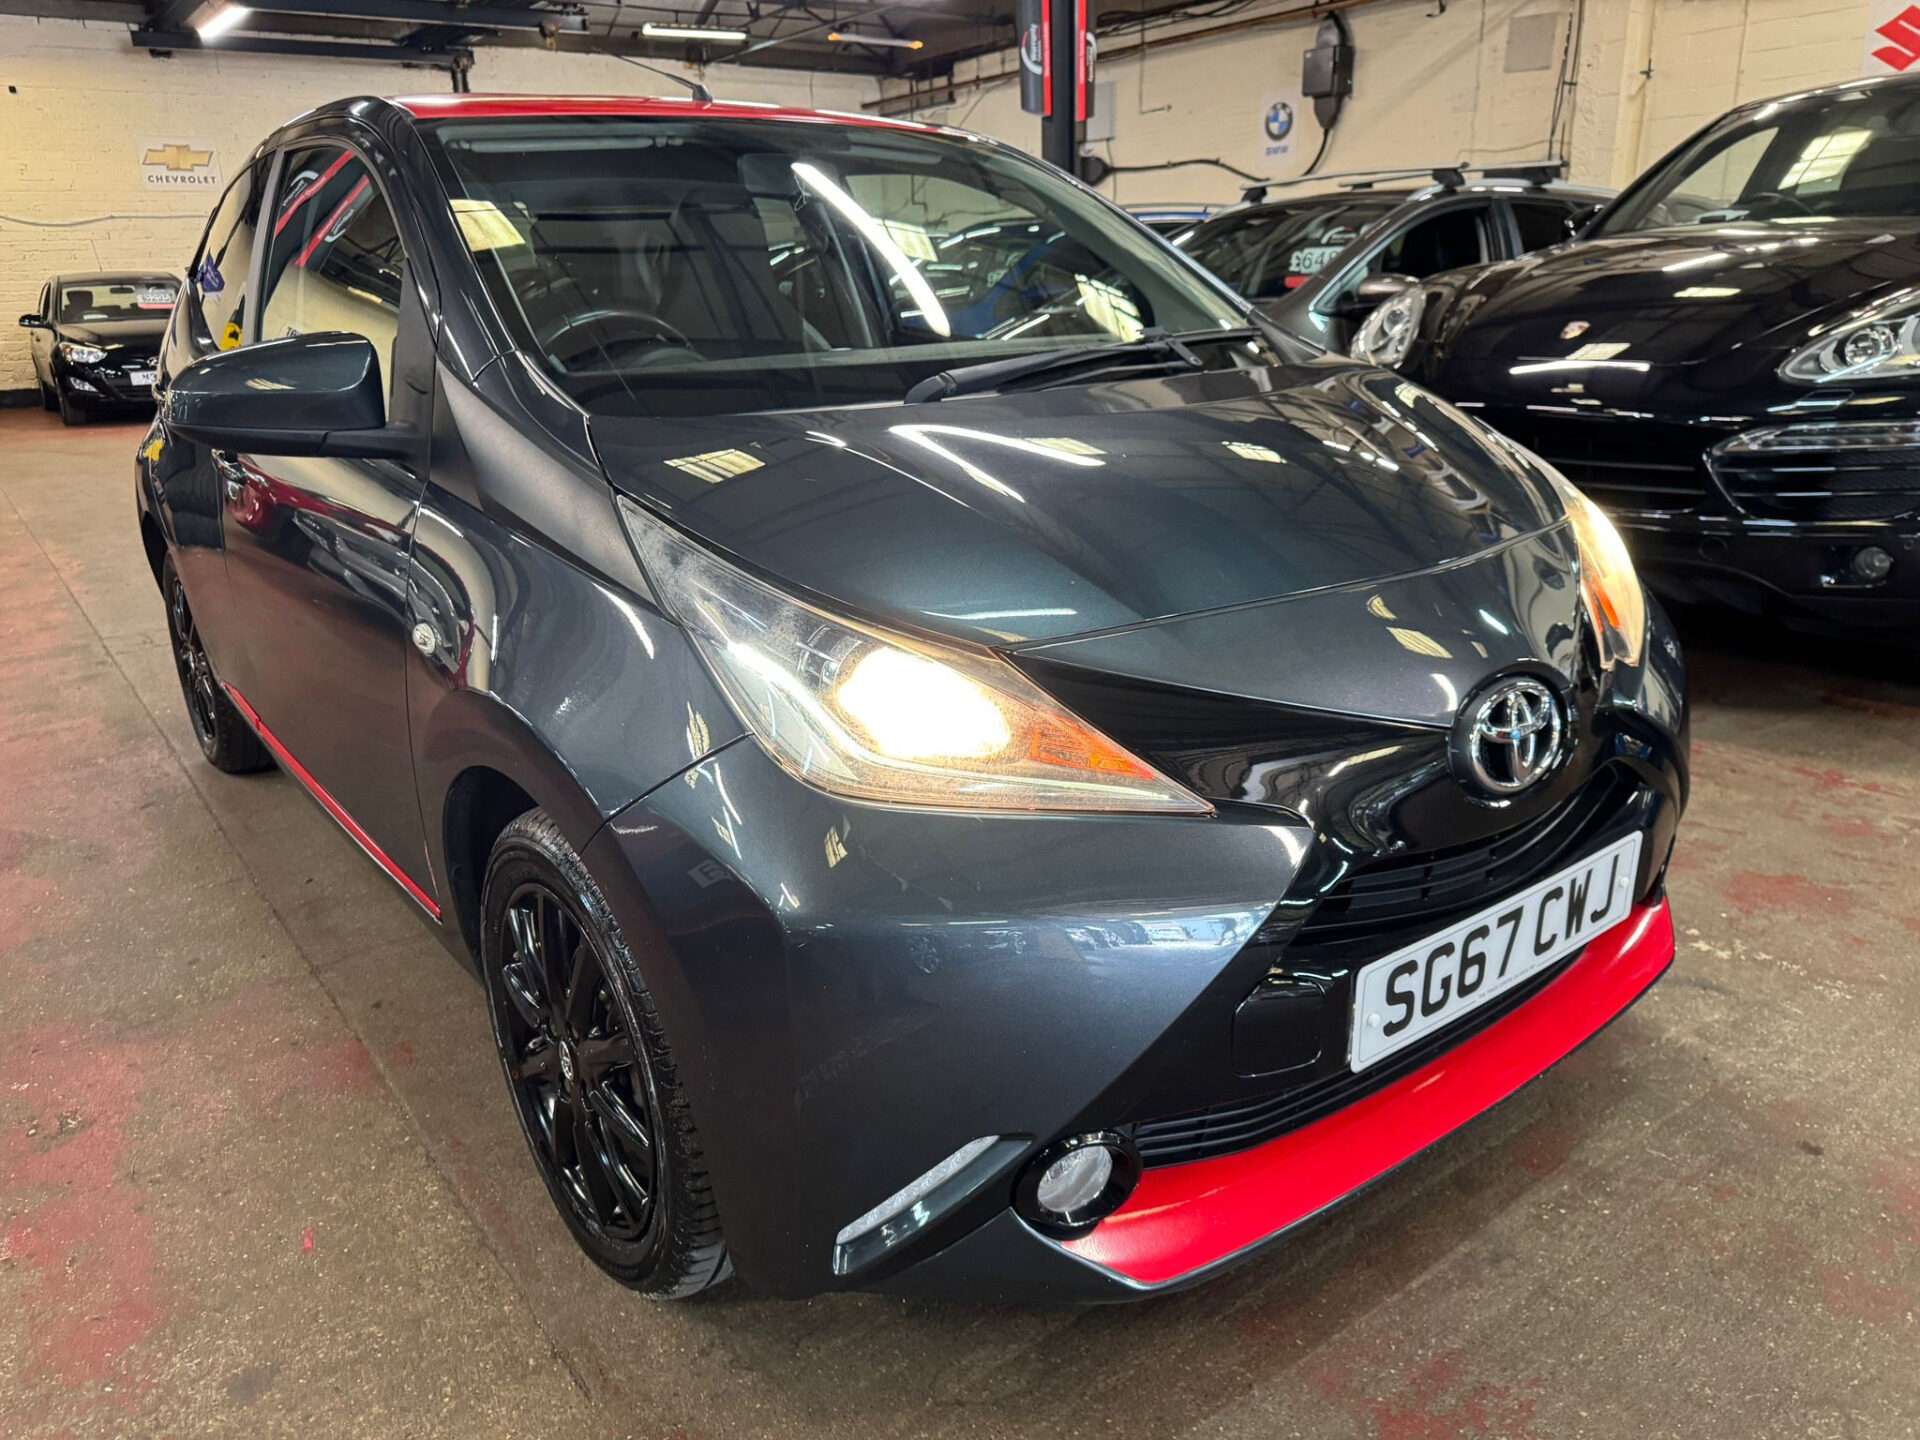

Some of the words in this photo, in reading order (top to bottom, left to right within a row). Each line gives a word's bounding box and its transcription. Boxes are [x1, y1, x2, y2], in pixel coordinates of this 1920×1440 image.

[148, 174, 216, 184] CHEVROLET
[1383, 906, 1524, 1038] SG67
[1534, 854, 1620, 957] CWJ
